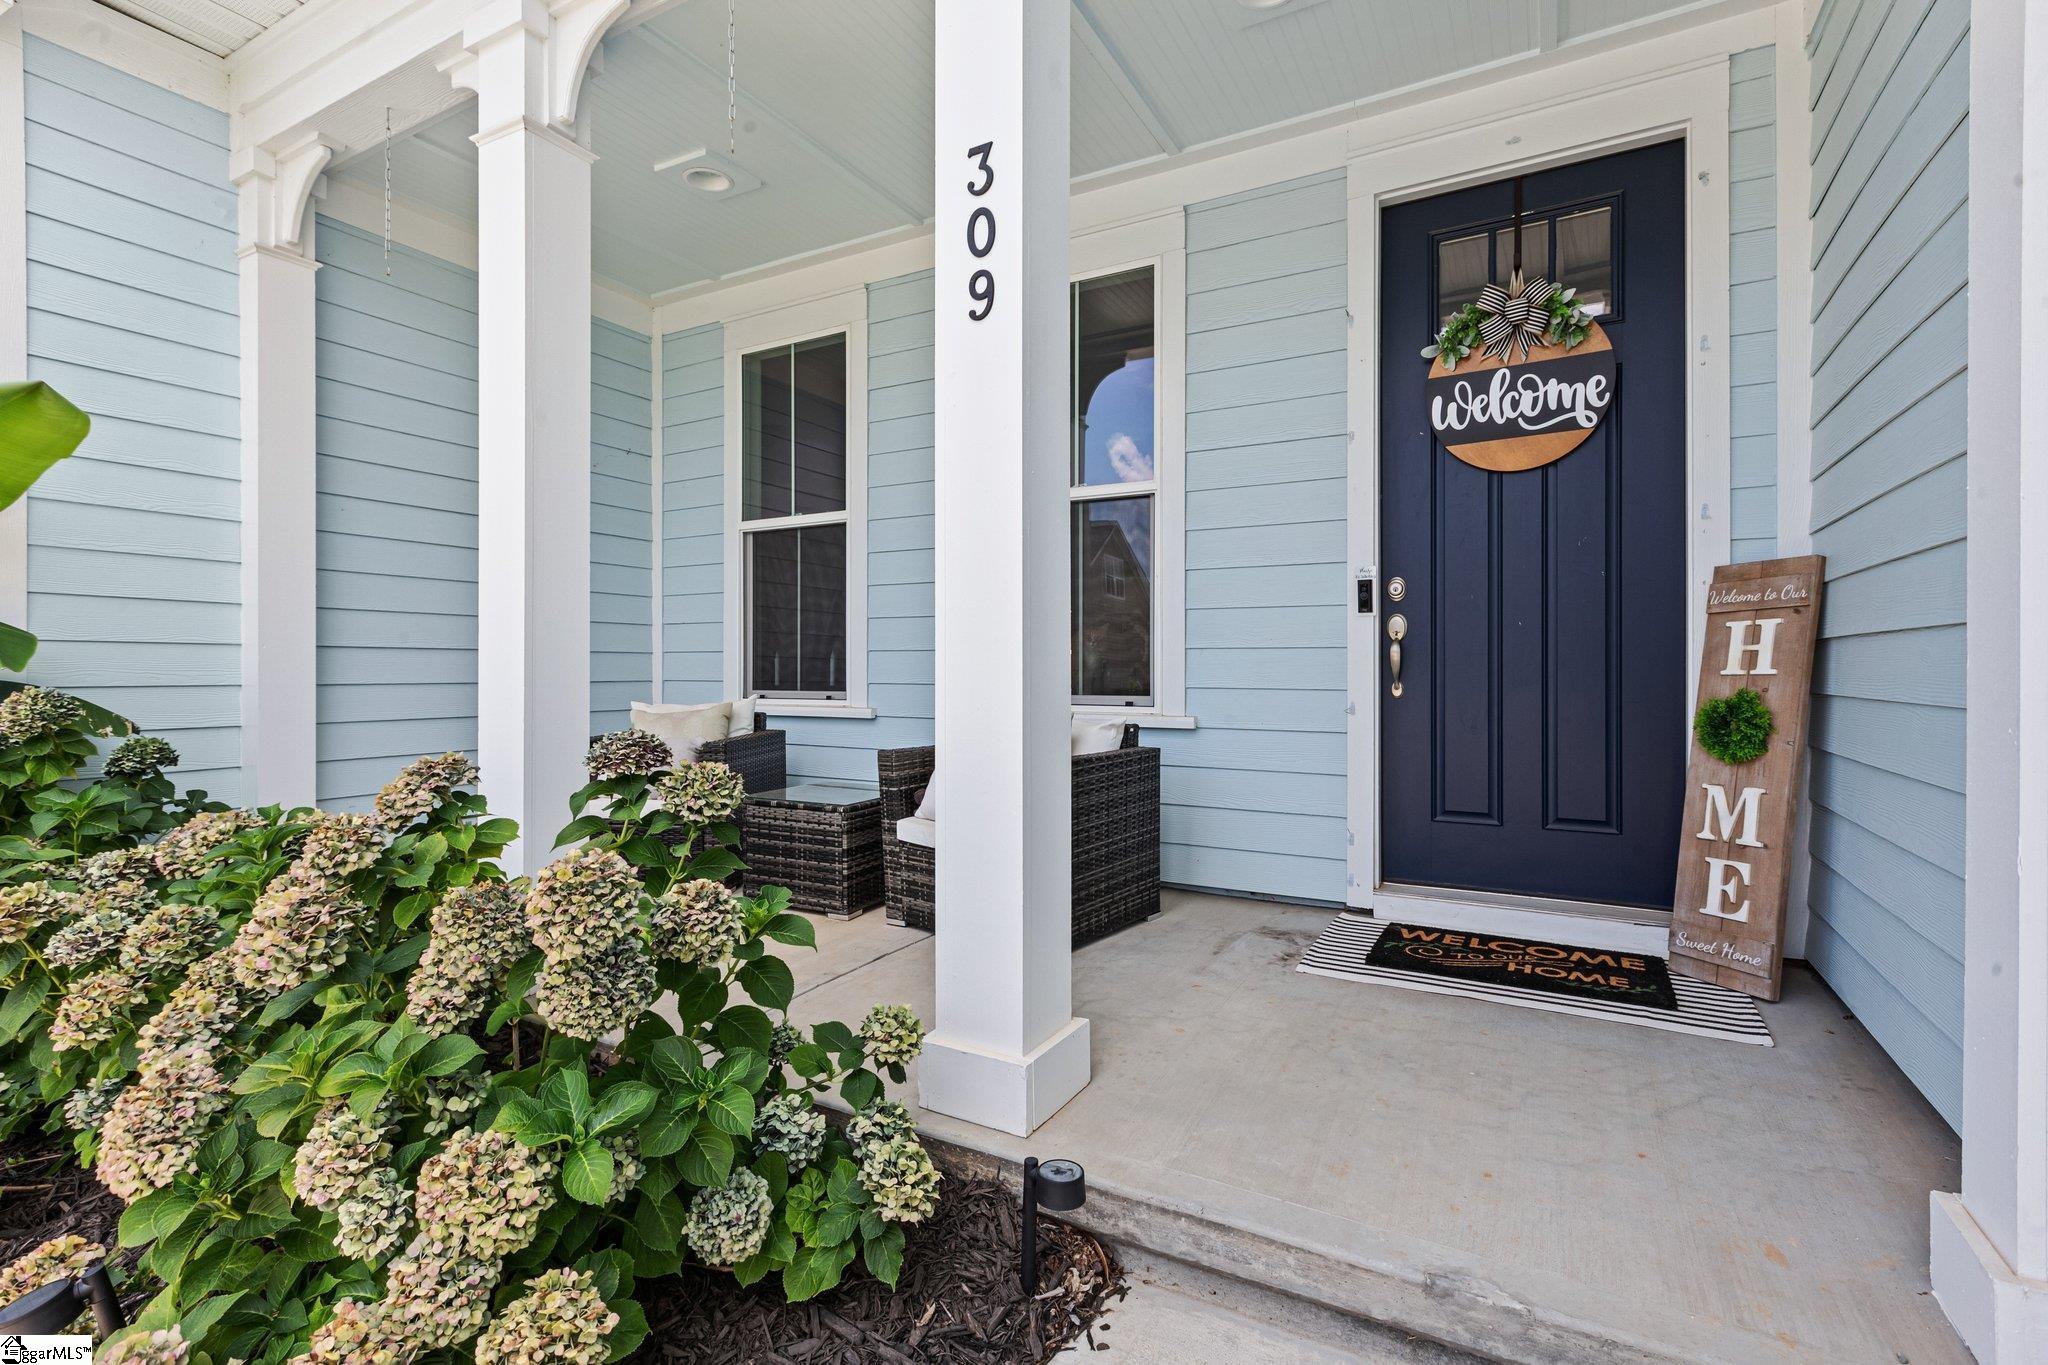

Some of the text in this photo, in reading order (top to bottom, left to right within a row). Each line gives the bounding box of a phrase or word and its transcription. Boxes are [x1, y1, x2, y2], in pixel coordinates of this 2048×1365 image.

[966, 140, 996, 322] 309
[1709, 584, 1808, 605] Welcome to Our
[1400, 927, 1646, 971] WELCOME
[1450, 950, 1539, 963] TO OUR
[1675, 931, 1763, 967] Sweet Home
[1507, 962, 1630, 989] HOME
